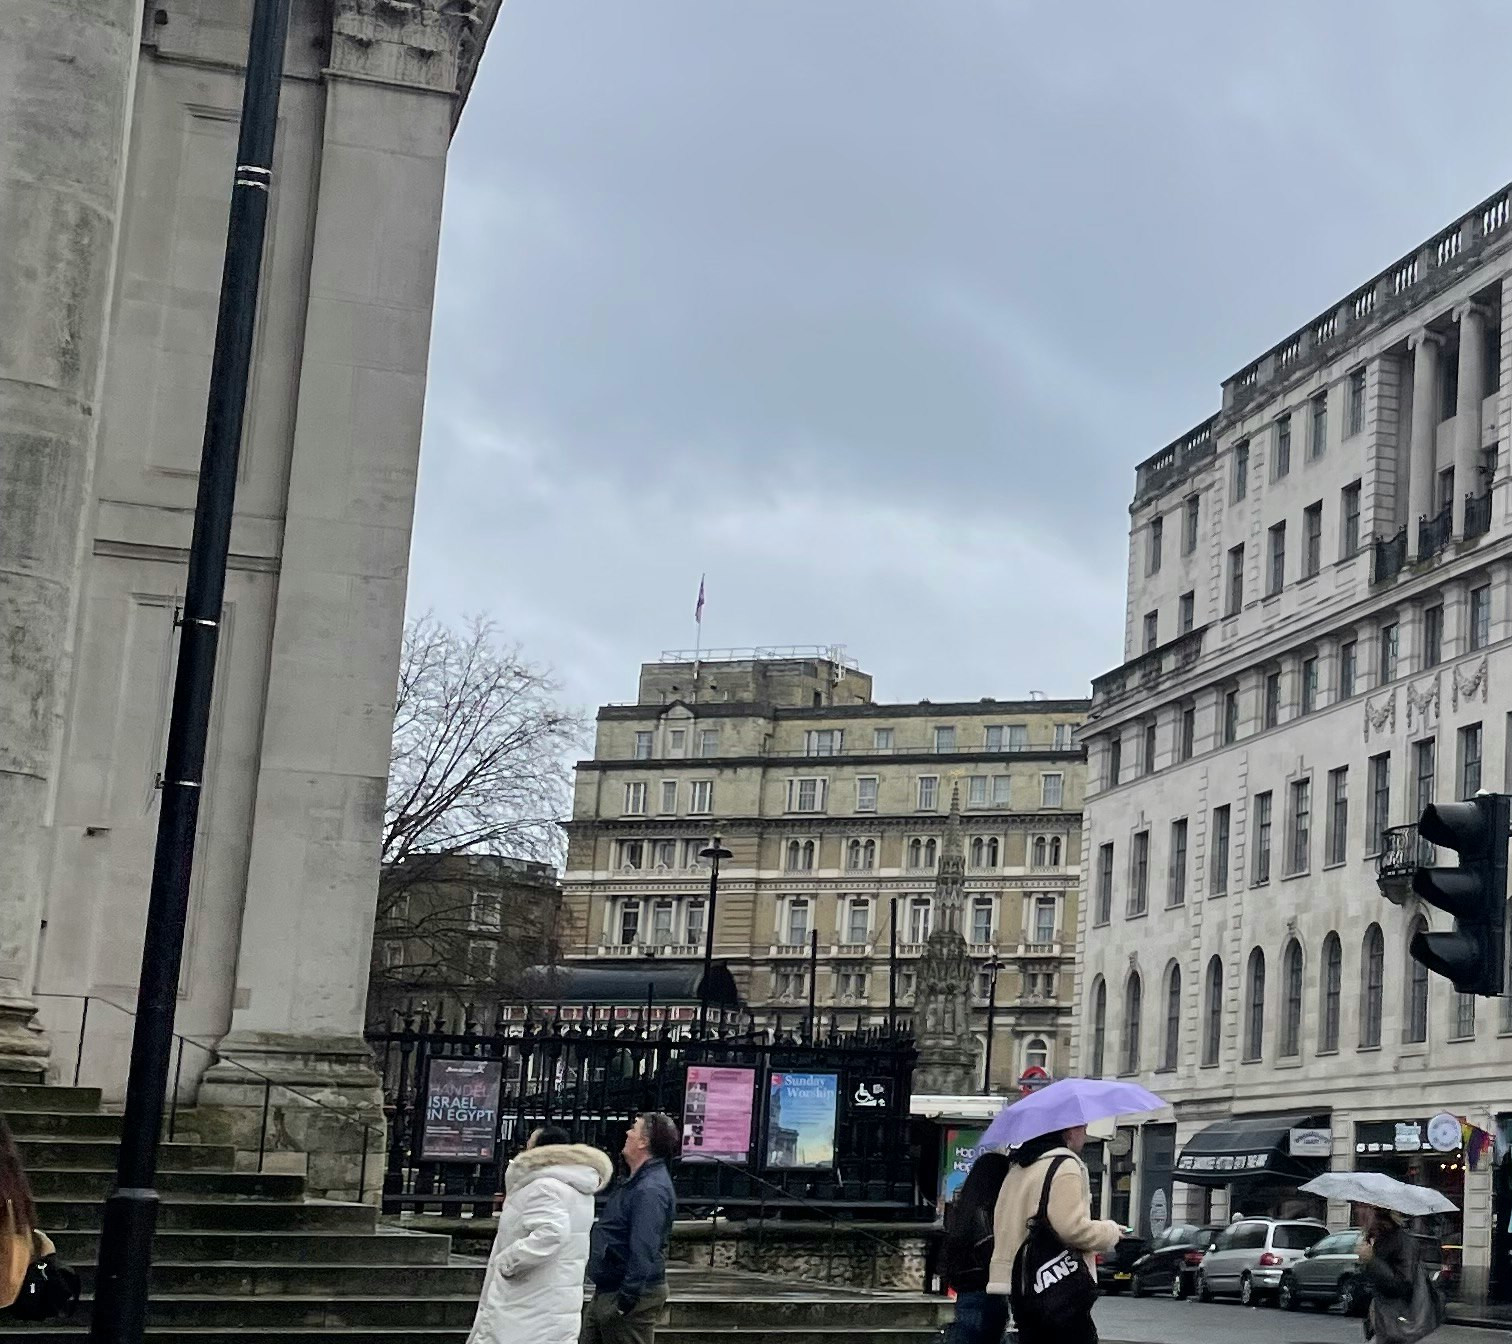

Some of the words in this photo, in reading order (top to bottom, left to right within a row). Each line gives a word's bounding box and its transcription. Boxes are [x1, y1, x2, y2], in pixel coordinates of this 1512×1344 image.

[784, 1075, 823, 1088] Sunday
[787, 1087, 834, 1099] Worship
[428, 1096, 477, 1109] ISRAEL
[427, 1109, 442, 1120] IN
[447, 1110, 494, 1121] EGYPT
[1033, 1250, 1078, 1293] VANS
